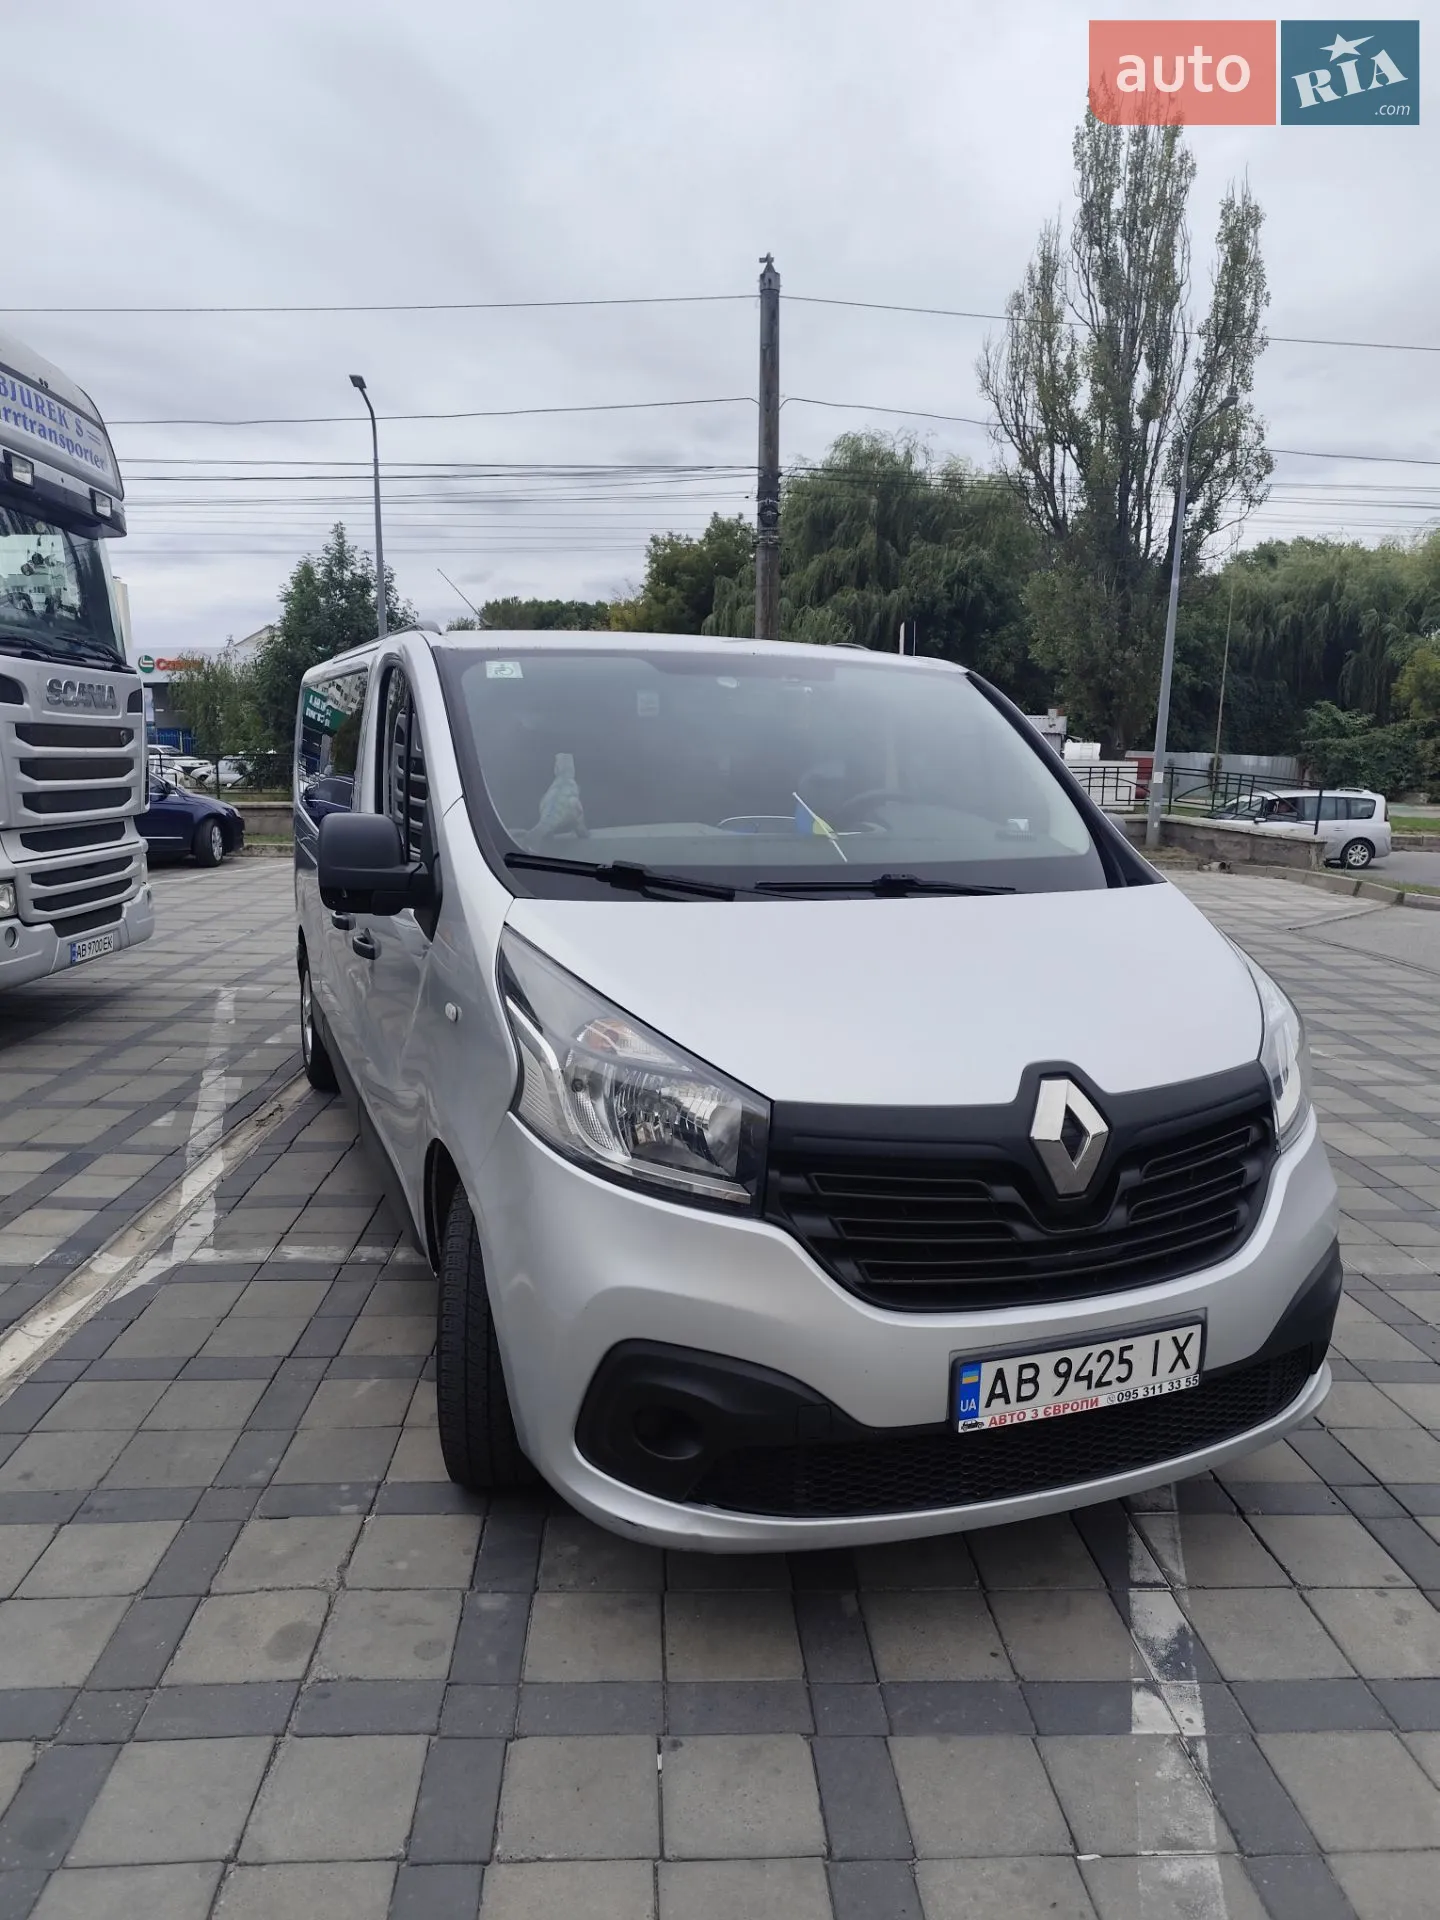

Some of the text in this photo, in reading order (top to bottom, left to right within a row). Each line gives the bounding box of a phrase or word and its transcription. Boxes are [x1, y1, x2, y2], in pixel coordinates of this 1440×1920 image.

[46, 678, 117, 710] SCANIA
[77, 943, 86, 958] AB
[103, 935, 113, 951] EK
[985, 1362, 1040, 1409] AB
[1053, 1344, 1134, 1398] 9425
[960, 1398, 977, 1412] UA
[988, 1411, 1027, 1427] АВТО
[1043, 1396, 1099, 1416] ЄВРОПИ
[1116, 1389, 1139, 1403] 095
[1142, 1384, 1163, 1397] 311
[1167, 1379, 1182, 1391] 33
[1185, 1375, 1199, 1387] 55
